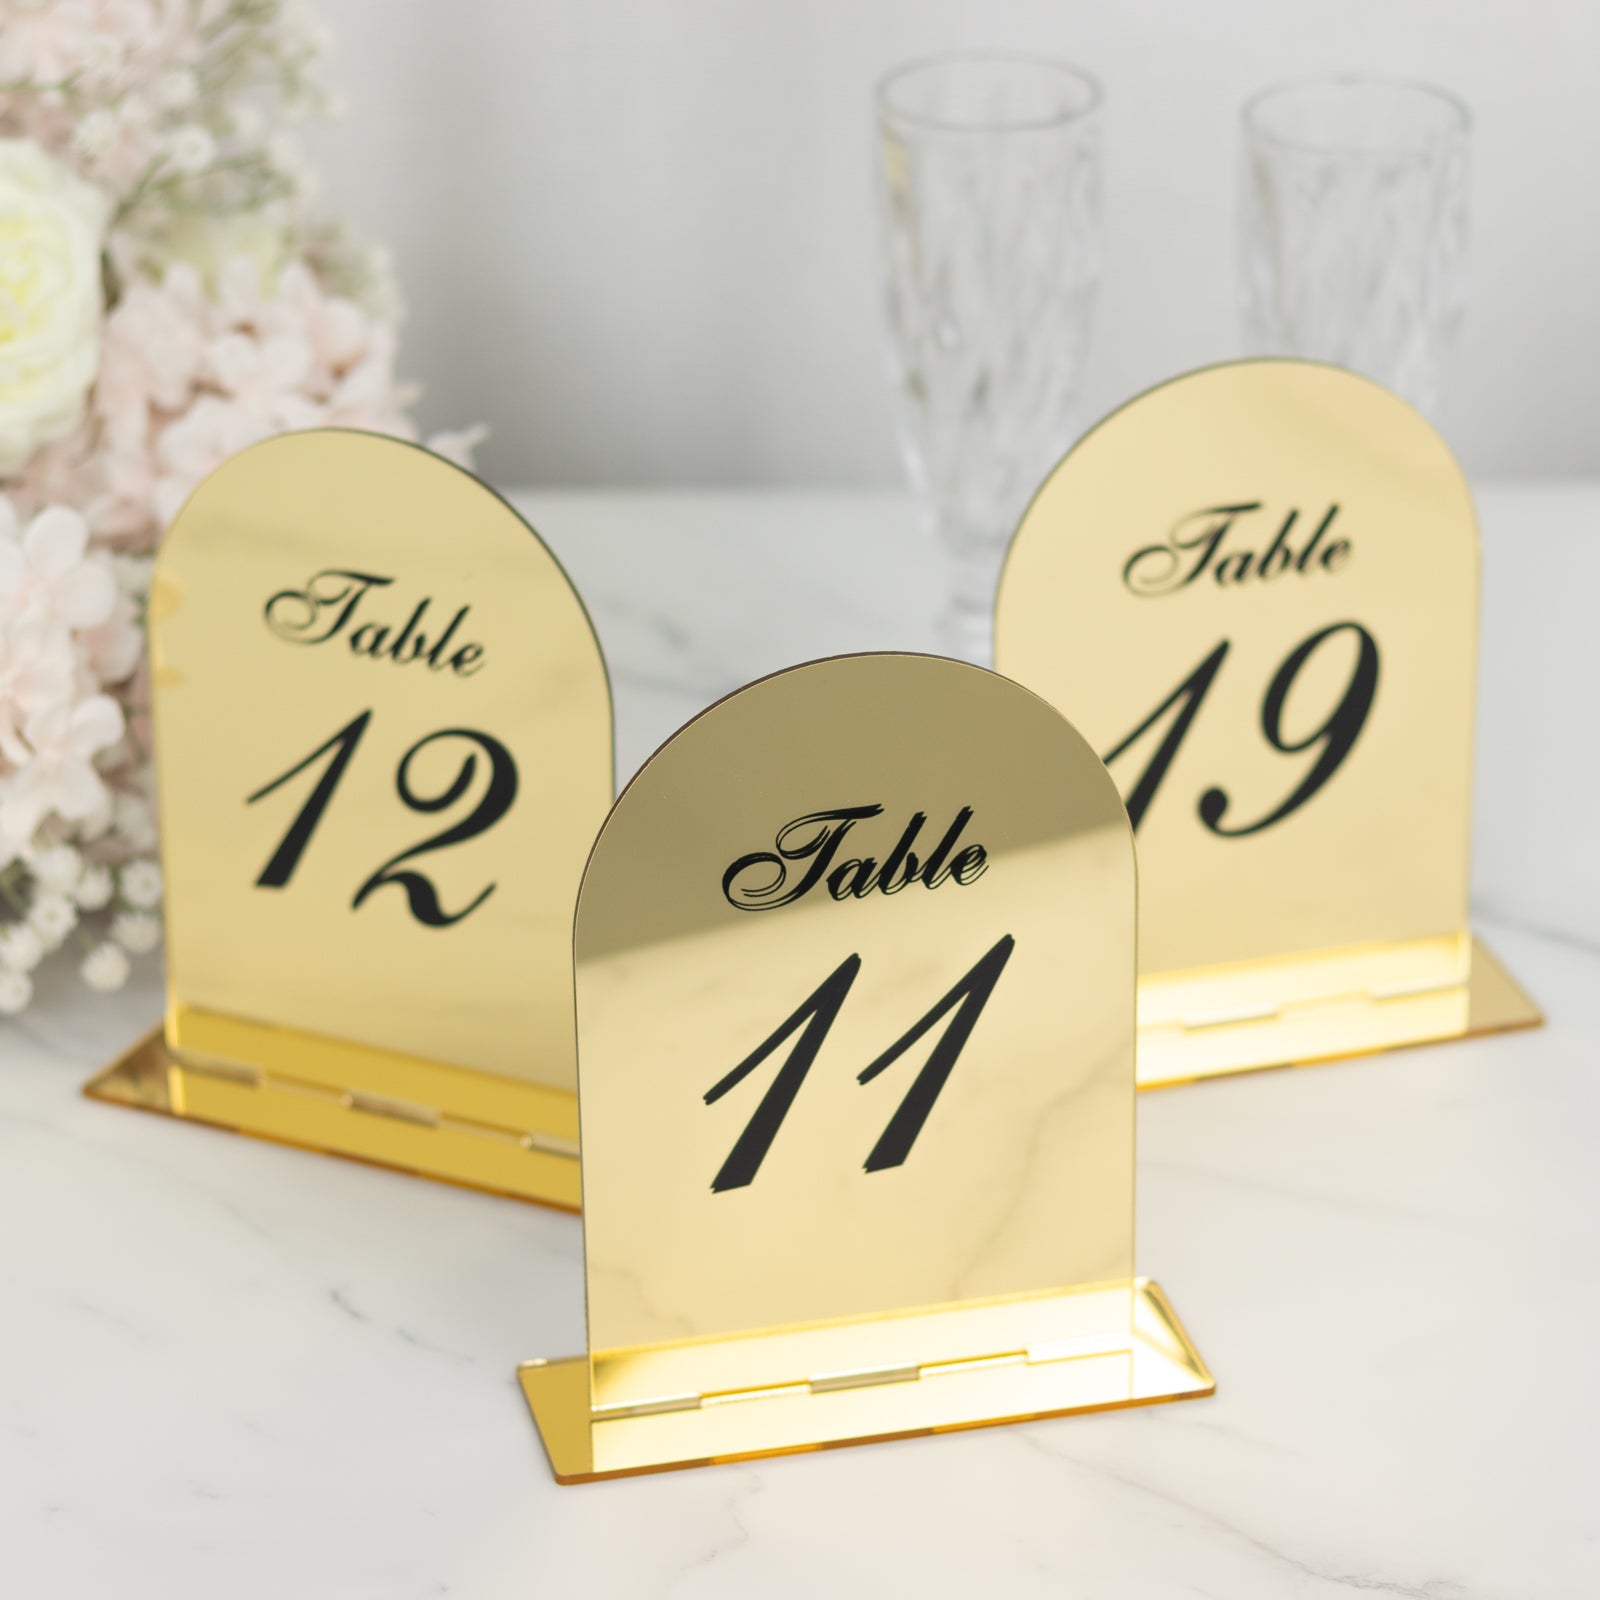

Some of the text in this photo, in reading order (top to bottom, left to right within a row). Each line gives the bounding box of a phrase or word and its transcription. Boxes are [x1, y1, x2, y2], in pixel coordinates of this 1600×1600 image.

[263, 568, 486, 678] Table
[1122, 501, 1354, 598] Table
[1103, 620, 1382, 839] 19
[246, 707, 520, 930] 12
[721, 802, 990, 912] Table
[702, 933, 1016, 1194] 11
